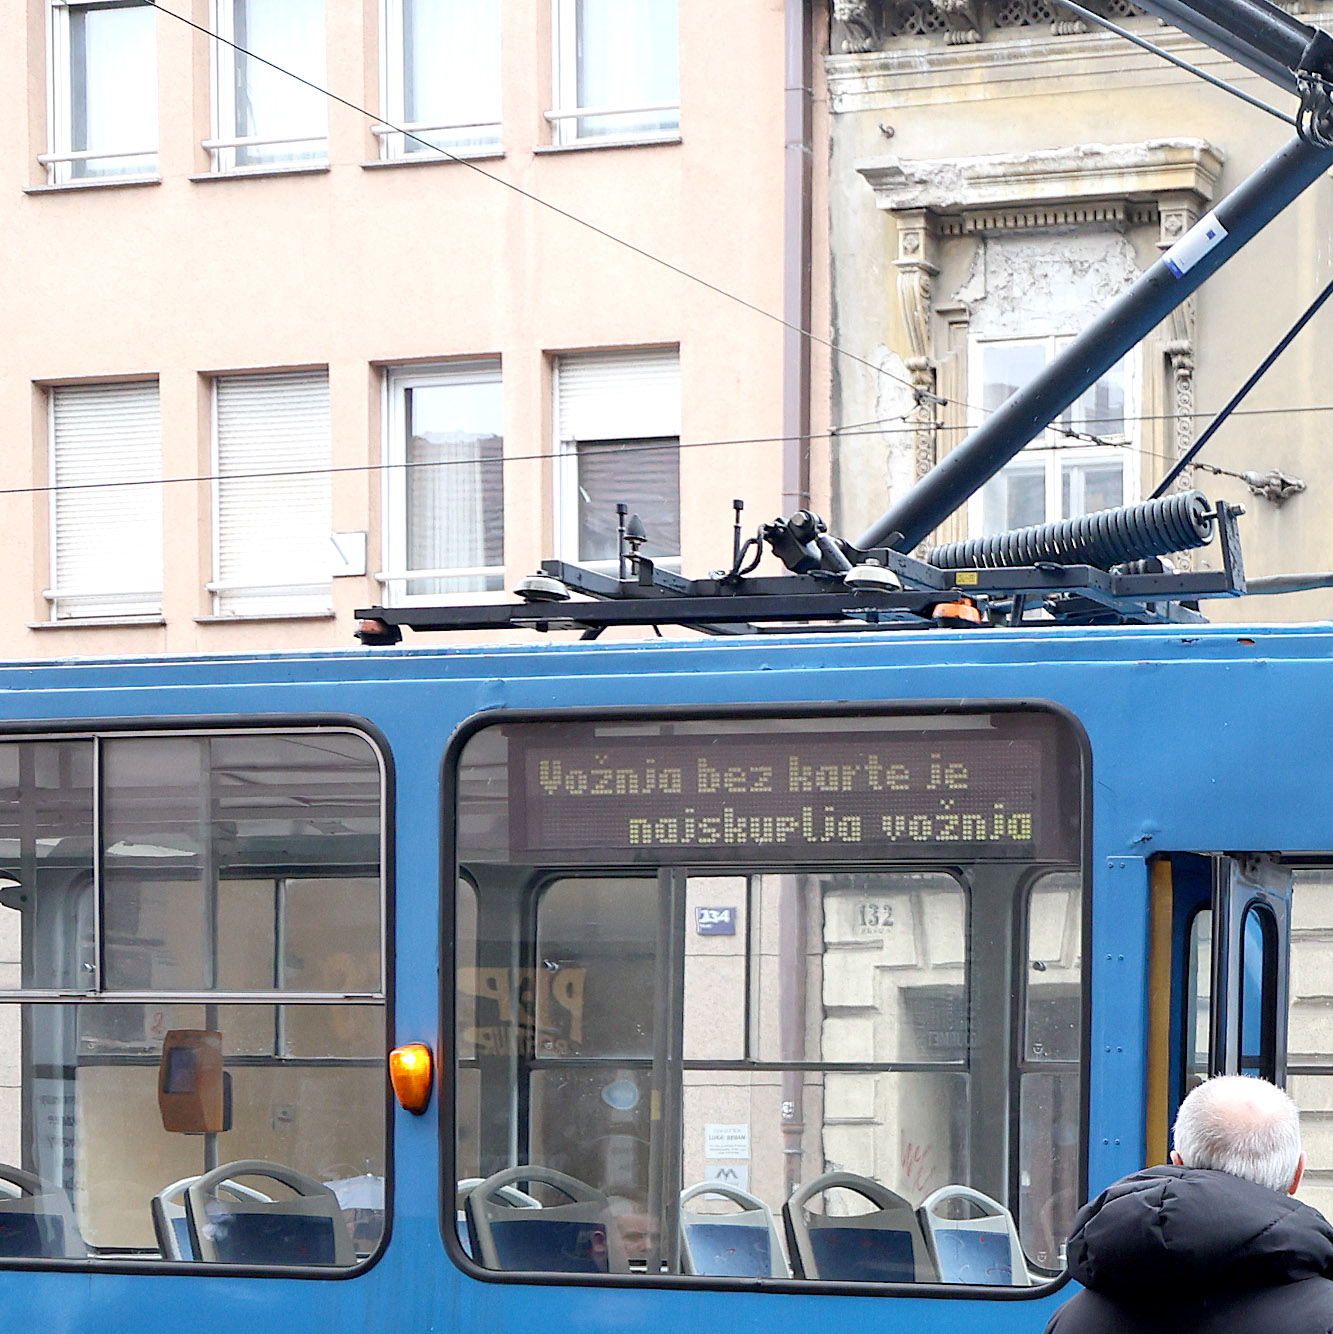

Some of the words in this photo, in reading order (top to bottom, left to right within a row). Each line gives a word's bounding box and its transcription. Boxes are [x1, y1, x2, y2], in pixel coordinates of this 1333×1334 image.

[538, 755, 683, 795] Vožnja
[698, 756, 773, 793] bez
[788, 754, 910, 792] karte
[926, 753, 969, 790] je
[629, 806, 862, 844] najskuplja
[881, 799, 1033, 842] vožnja
[860, 904, 894, 926] 132
